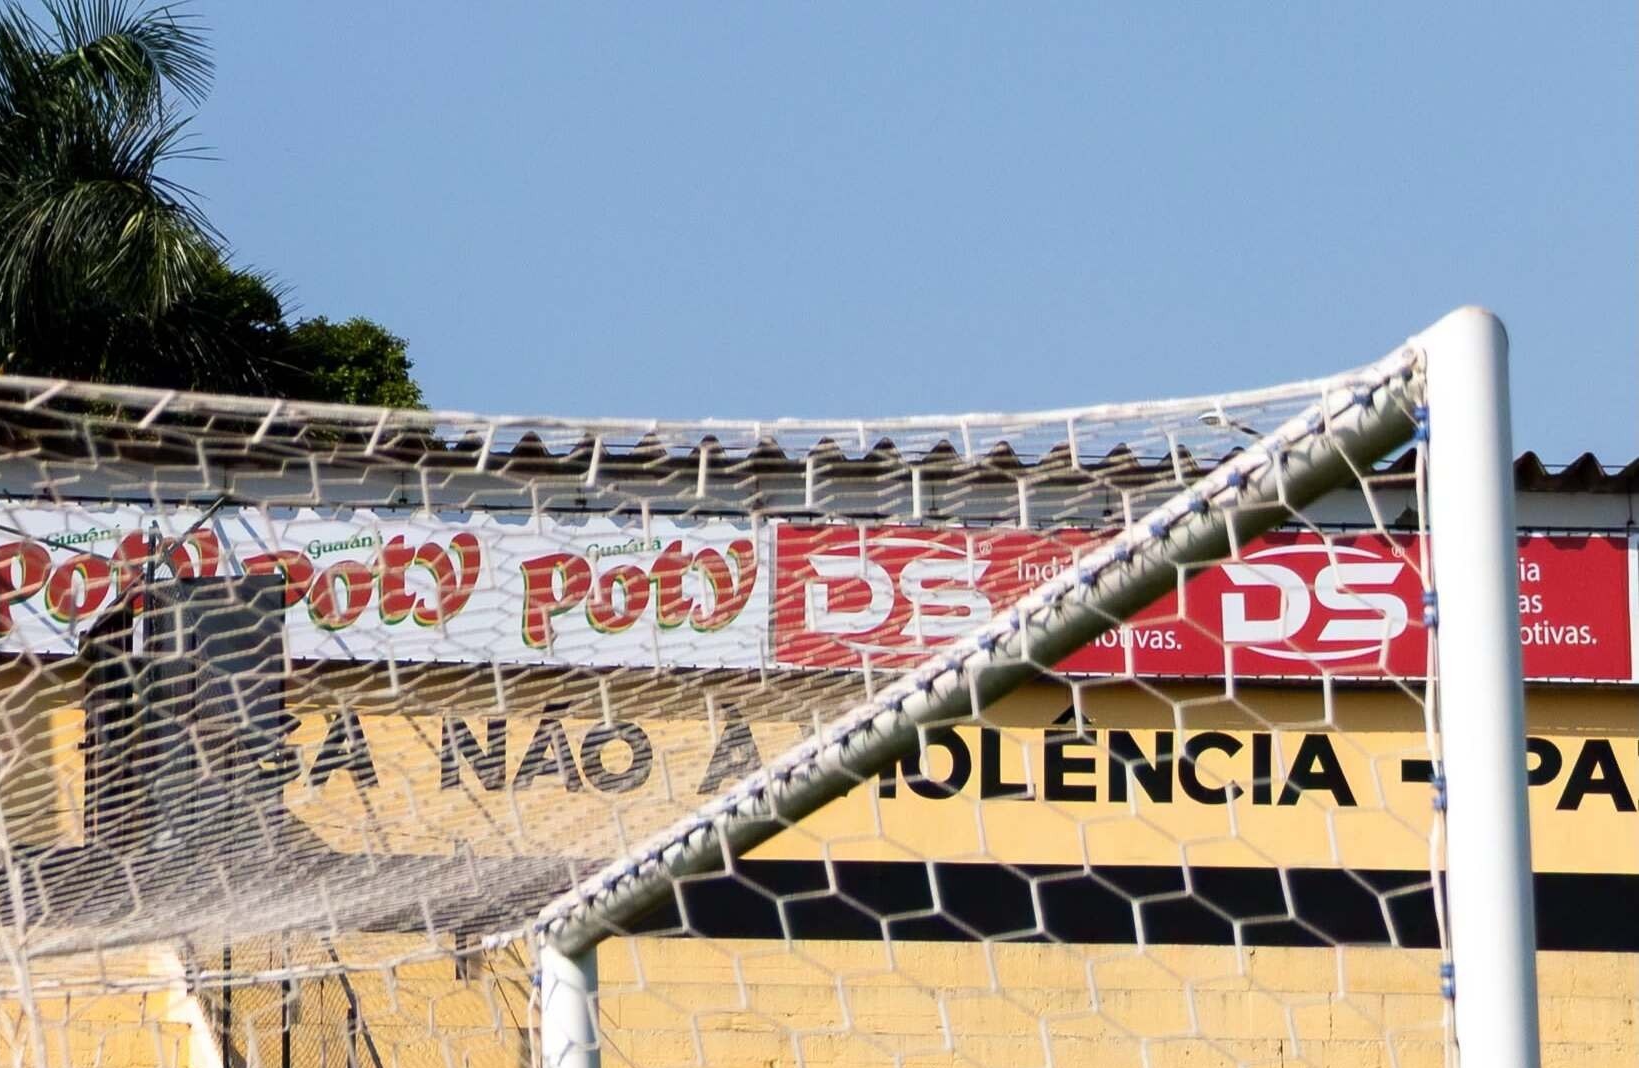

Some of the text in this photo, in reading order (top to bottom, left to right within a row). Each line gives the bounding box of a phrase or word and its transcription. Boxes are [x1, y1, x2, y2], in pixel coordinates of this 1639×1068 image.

[805, 555, 992, 637] DS
[1220, 562, 1408, 642] DS
[440, 701, 654, 794] NÃO
[1526, 737, 1639, 812] PA
